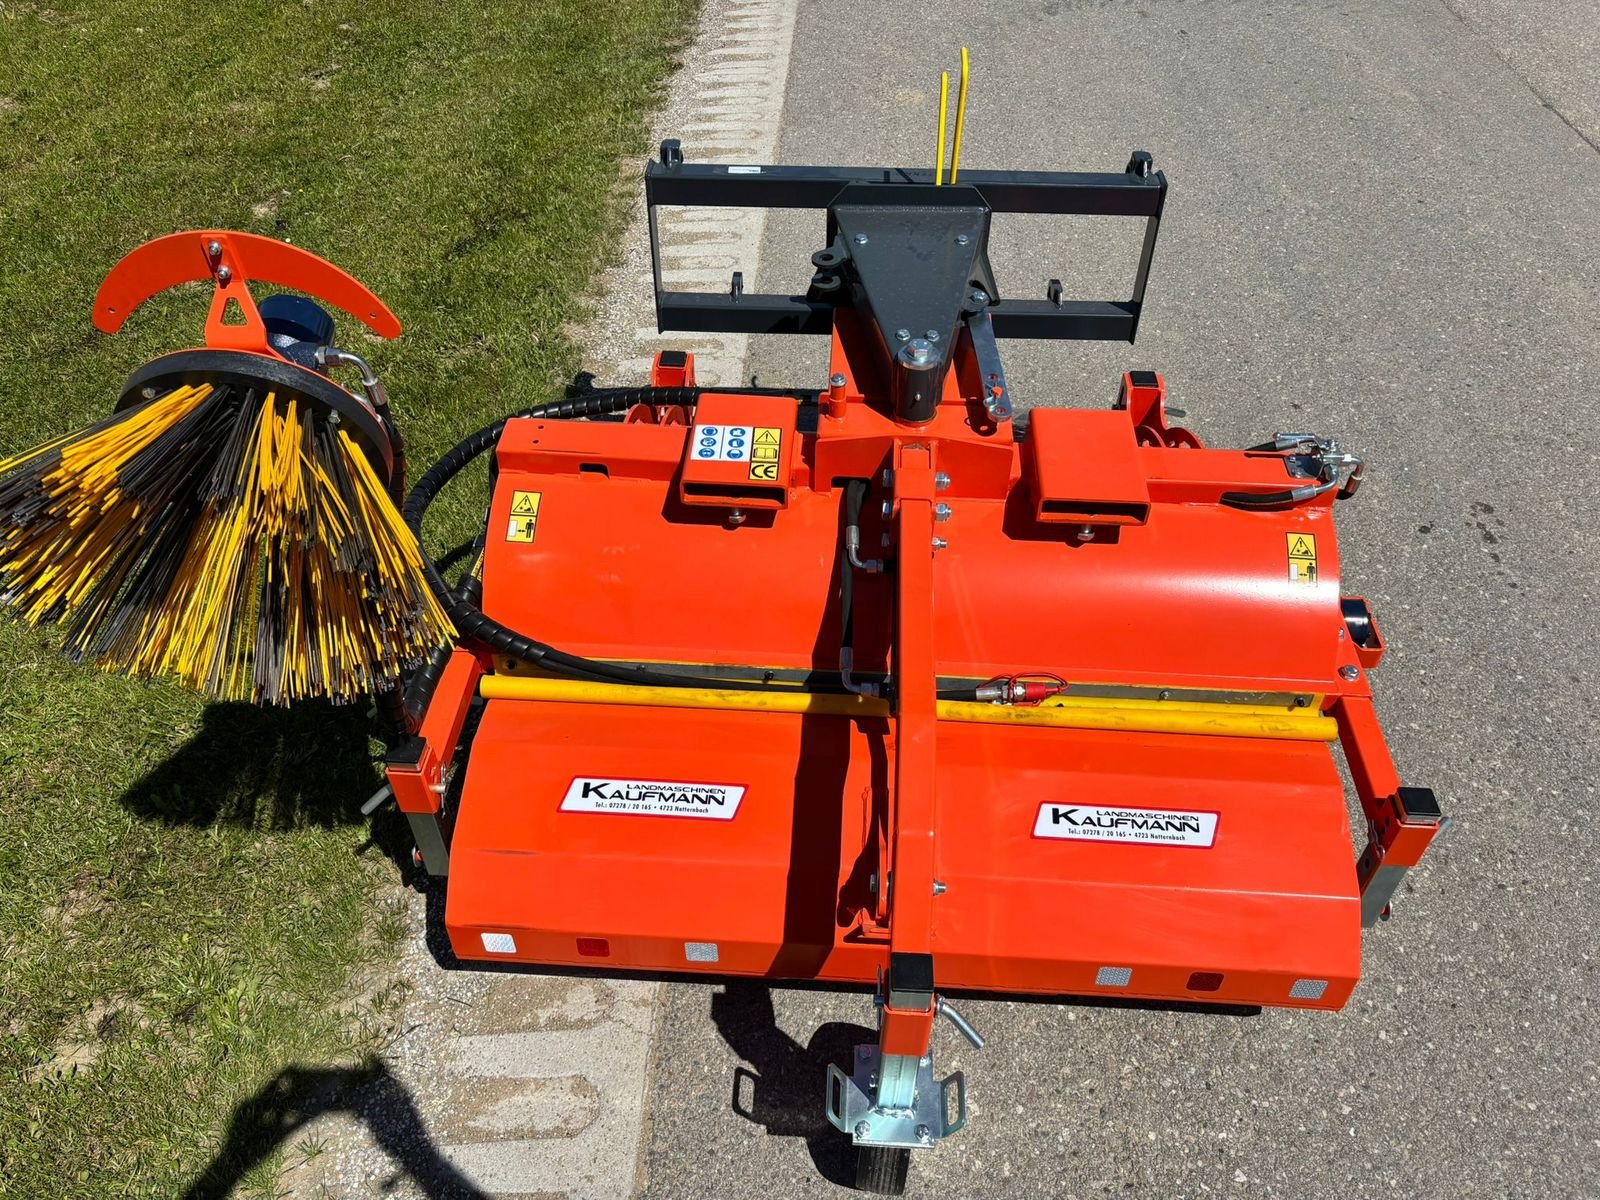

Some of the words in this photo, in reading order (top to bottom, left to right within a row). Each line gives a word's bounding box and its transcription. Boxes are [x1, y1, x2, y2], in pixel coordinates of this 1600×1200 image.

[751, 464, 776, 479] CE
[581, 782, 725, 806] KAUFMANN
[626, 784, 726, 795] LANDMASCHINEN
[674, 805, 709, 813] Natternbach
[1052, 808, 1200, 833] KAUFMANN
[1096, 810, 1199, 822] LANDMASCHINEN
[1150, 833, 1185, 841] Natternbach
